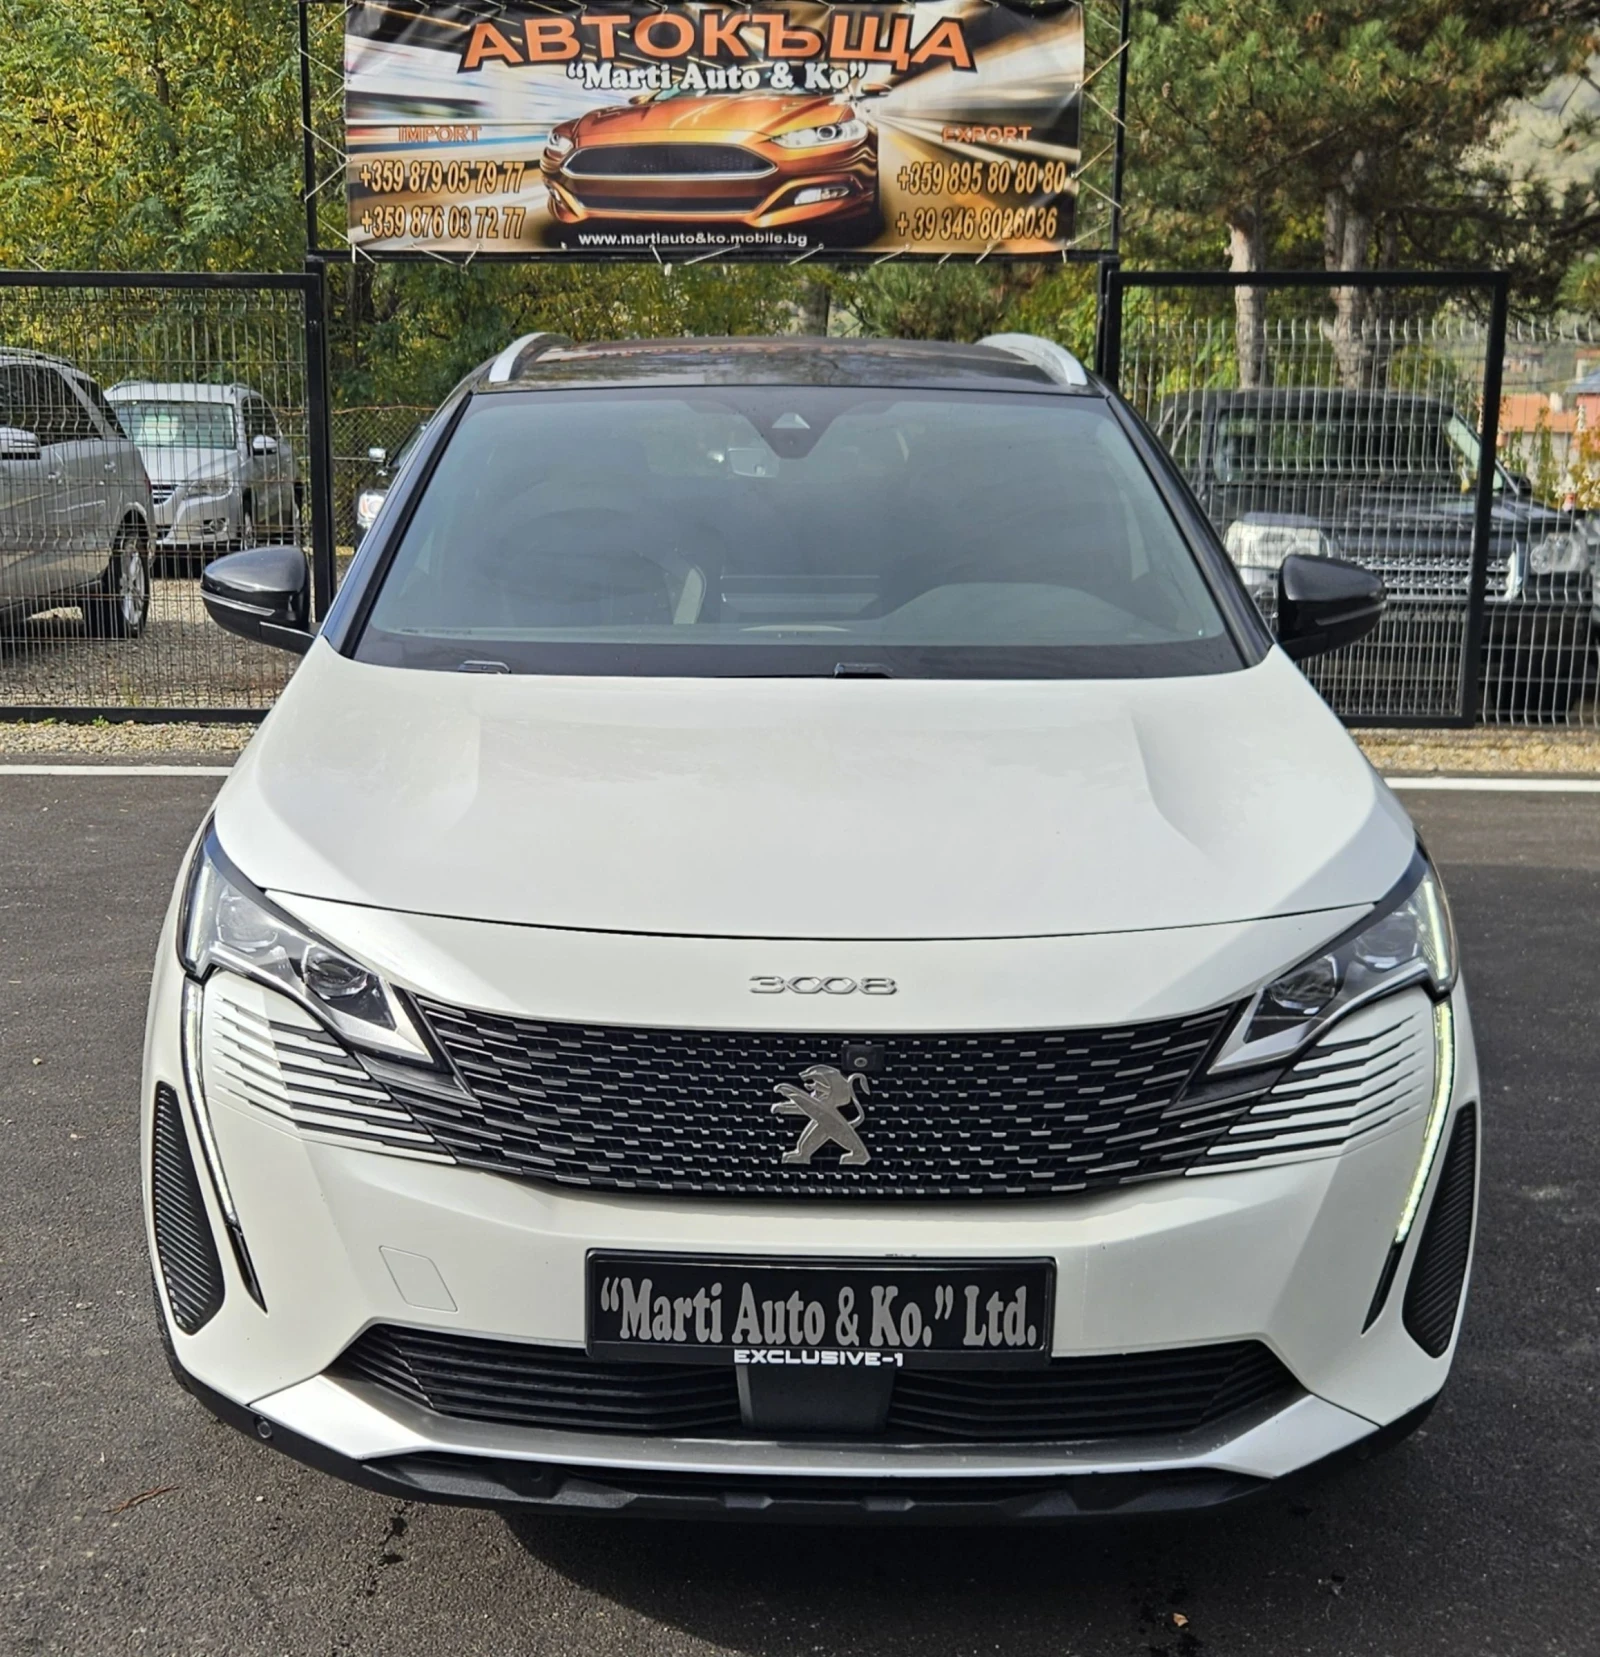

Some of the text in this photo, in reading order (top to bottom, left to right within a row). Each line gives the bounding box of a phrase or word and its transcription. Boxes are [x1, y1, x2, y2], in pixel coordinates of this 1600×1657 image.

[462, 12, 973, 71] АВТОКЪЩА
[567, 60, 867, 91] “Marti Auto & Ko”
[399, 124, 483, 143] IMPORT
[941, 125, 1032, 143] EXPORT
[360, 160, 525, 193] +359 879 05 79 77
[897, 161, 1066, 195] +359 895 80 80 80
[361, 205, 526, 239] +359 876 03 72 77
[939, 207, 976, 240] 346
[749, 975, 898, 996] 3008
[600, 1276, 1038, 1348] “Marti Auto & Ko.” Ltd.
[733, 1349, 904, 1367] EXCLUSIVE-1
